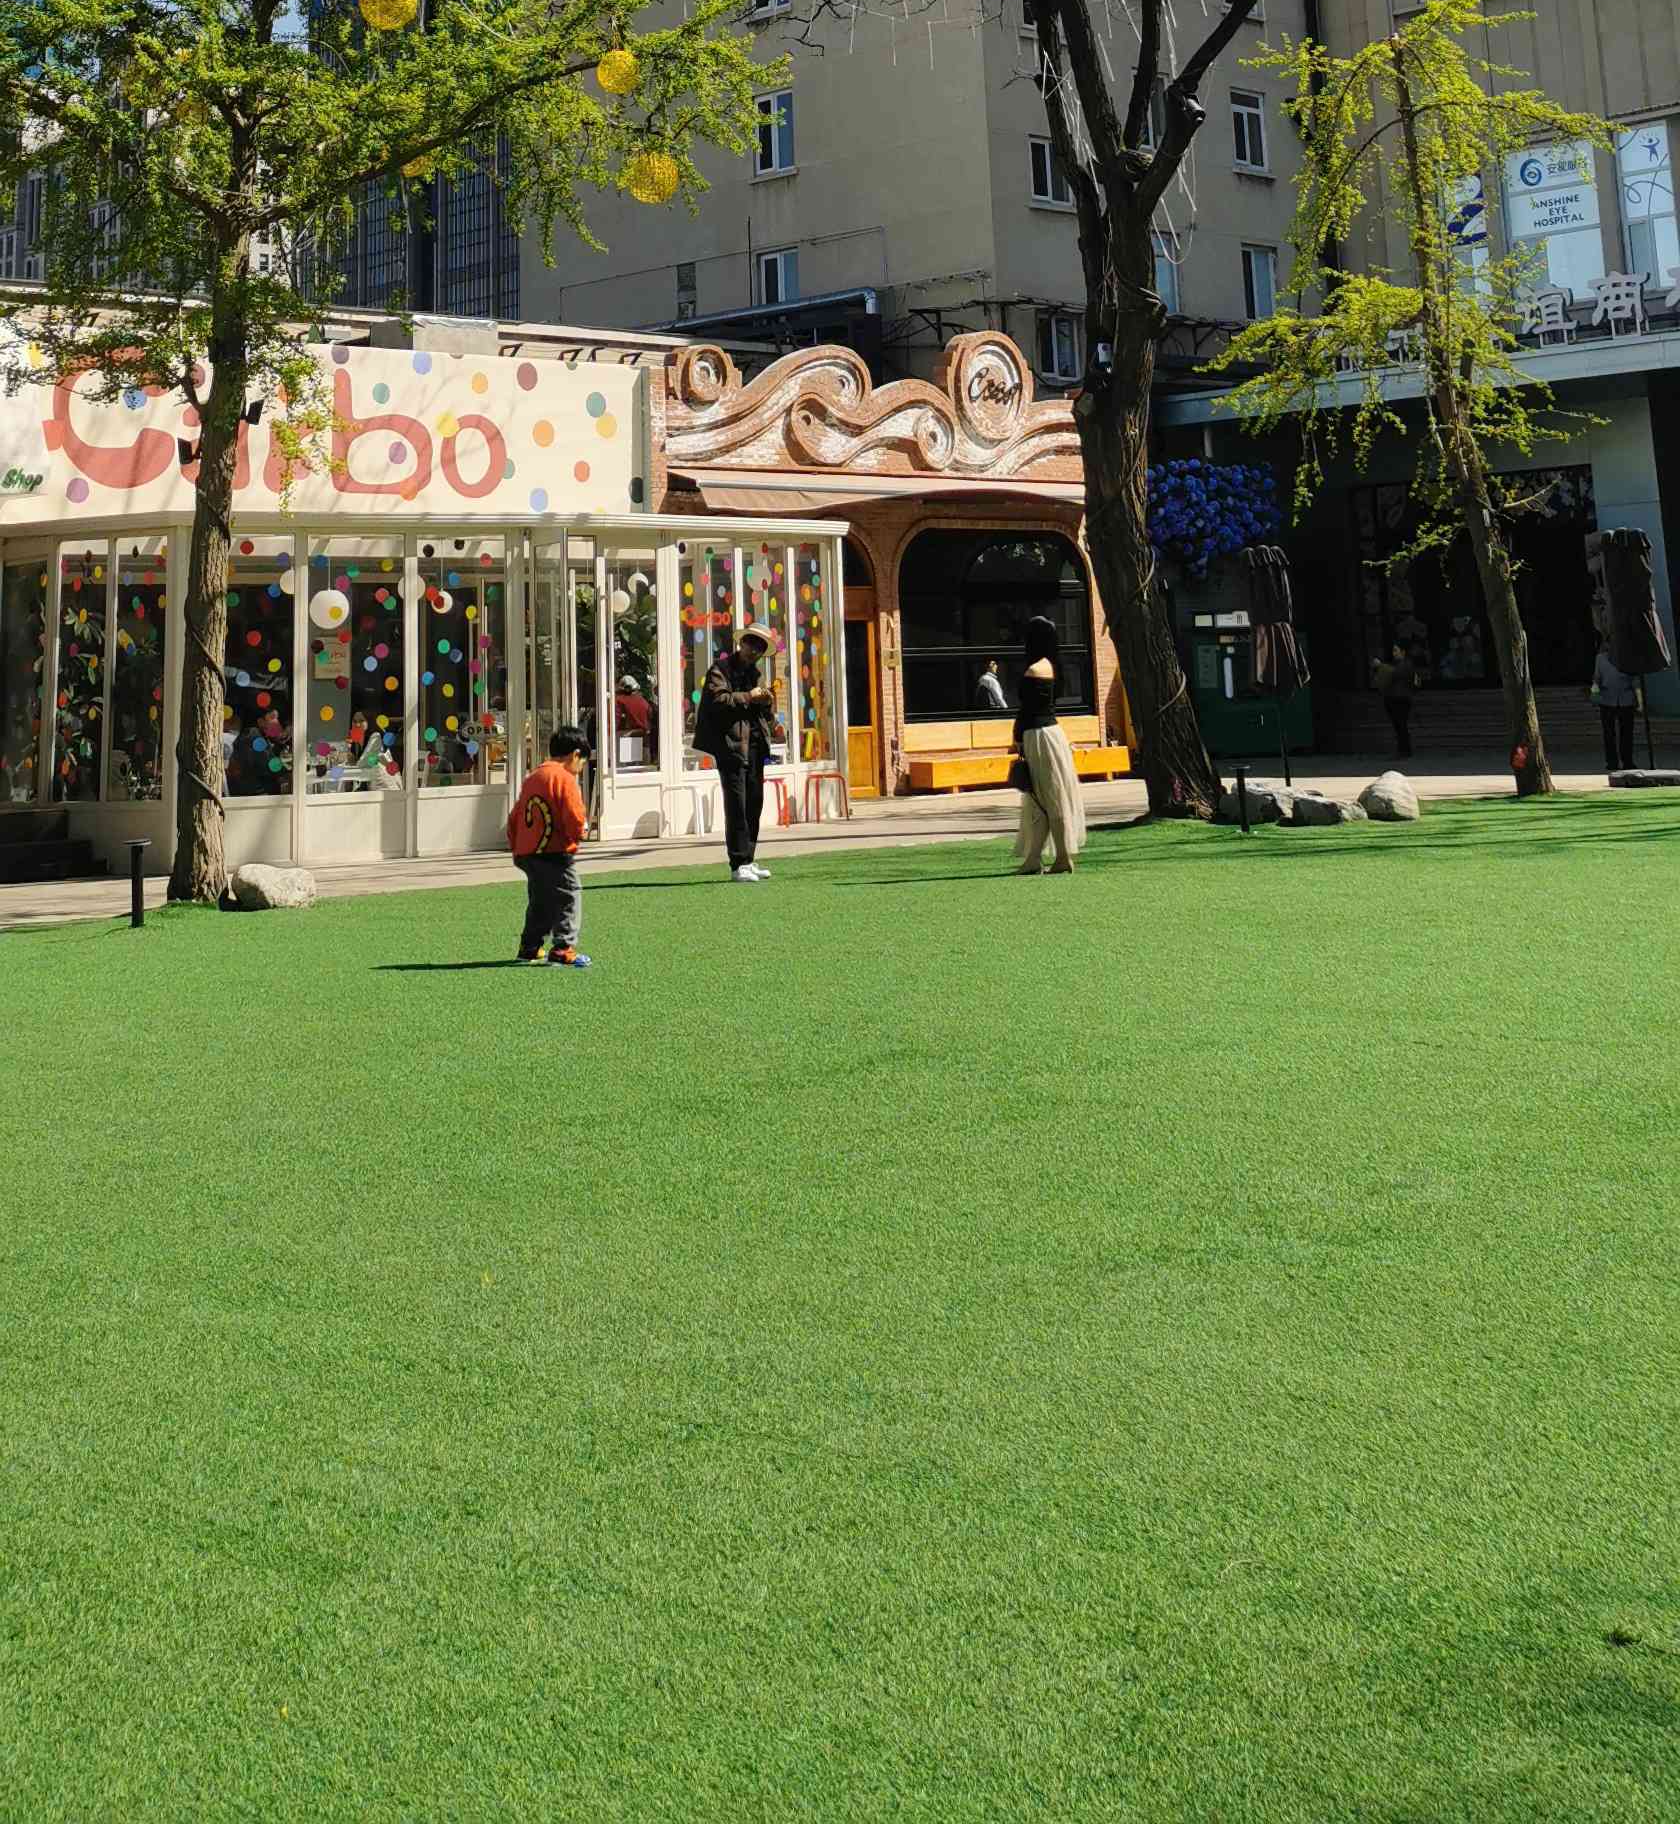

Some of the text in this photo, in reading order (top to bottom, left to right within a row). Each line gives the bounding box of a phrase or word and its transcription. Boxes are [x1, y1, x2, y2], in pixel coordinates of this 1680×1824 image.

[1549, 205, 1568, 217] EYE
[1533, 212, 1585, 229] HOSPITAL
[2, 467, 44, 492] Shop
